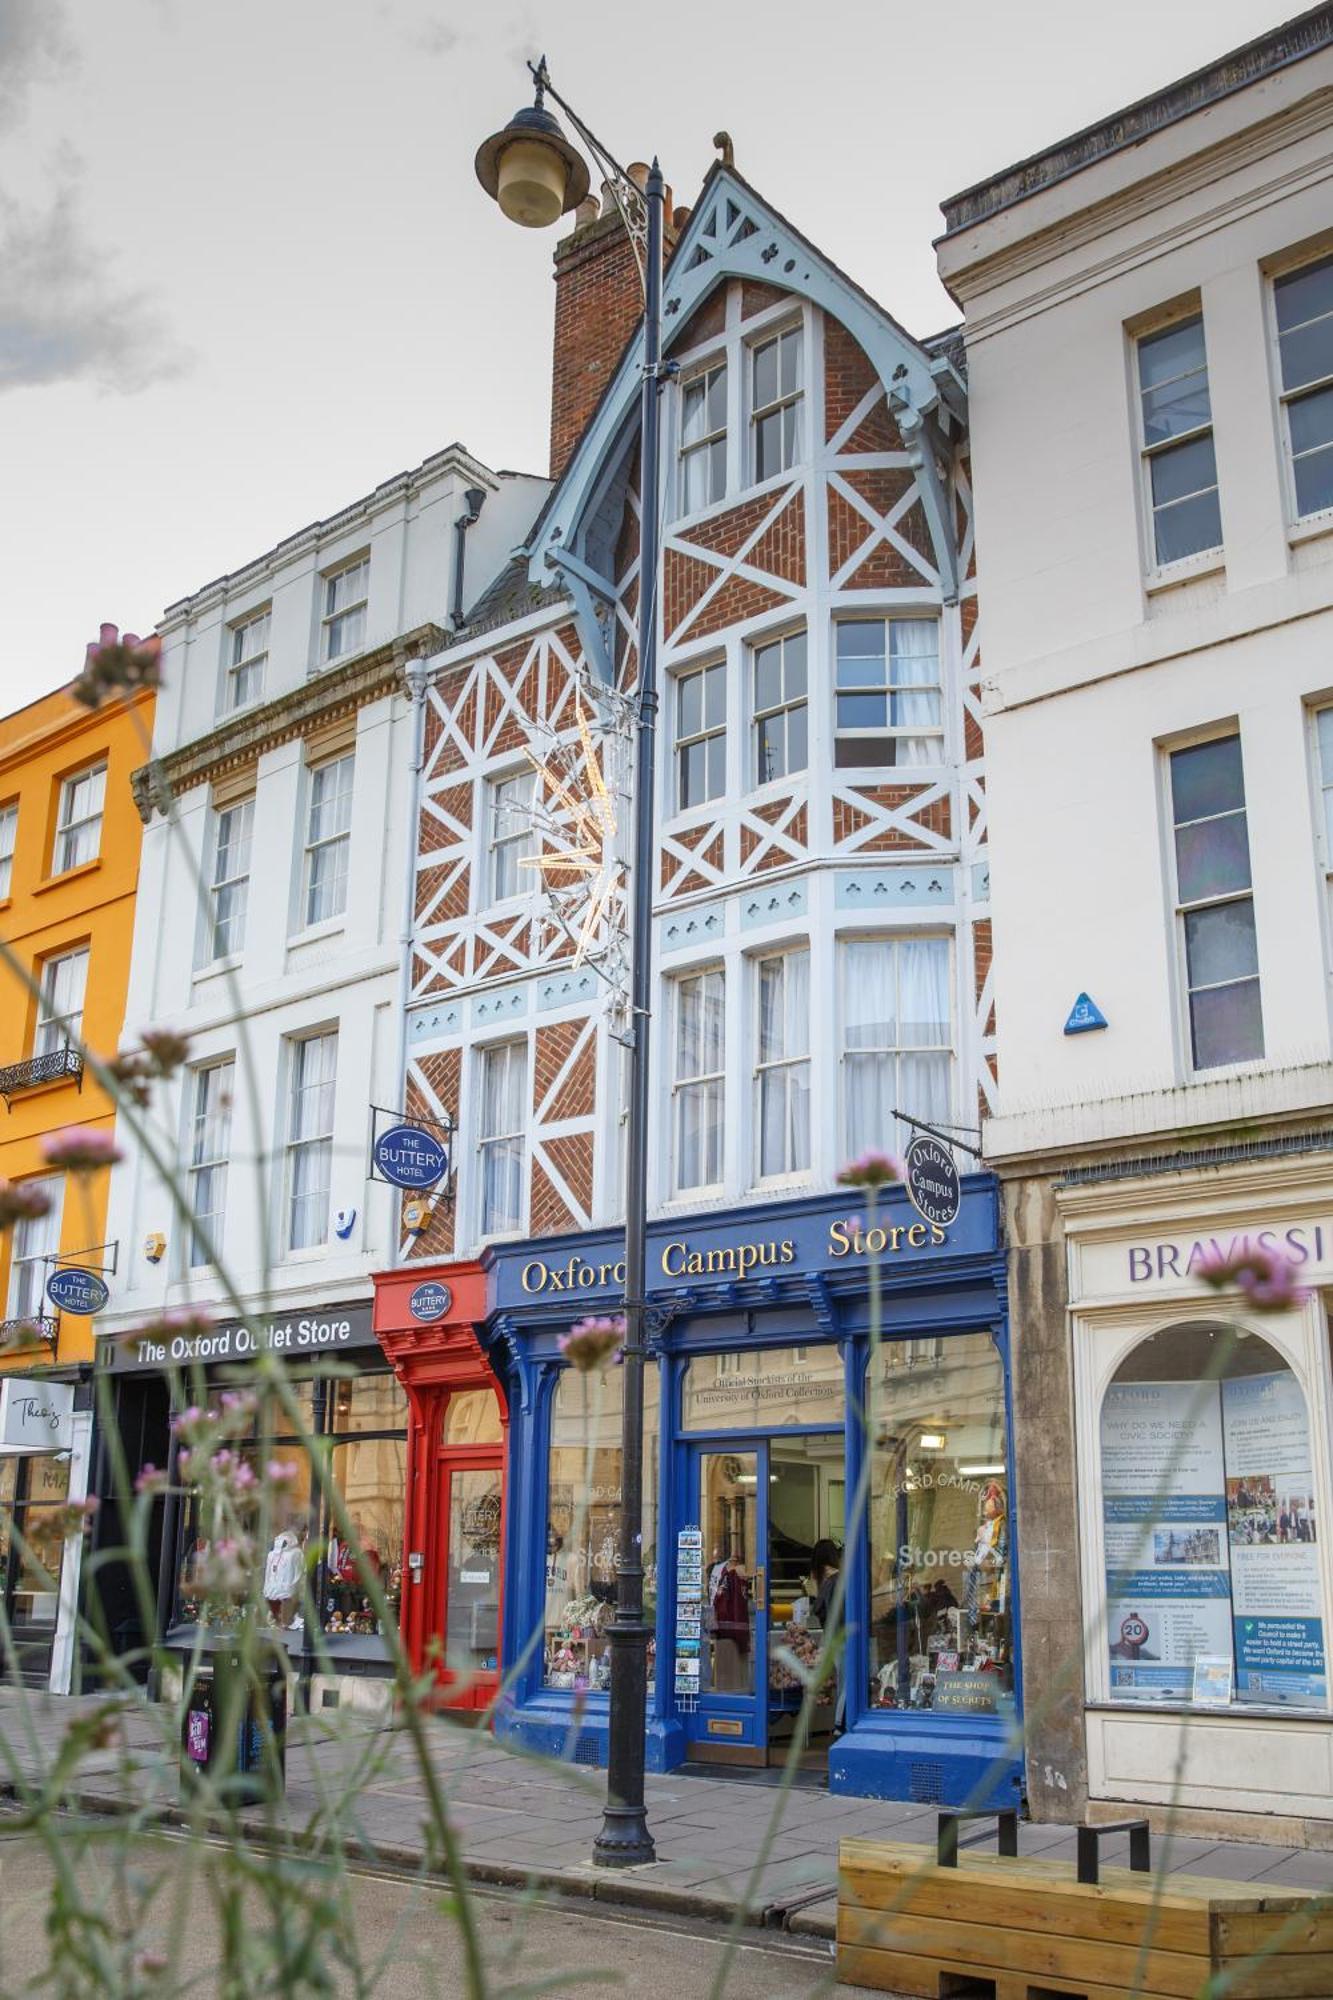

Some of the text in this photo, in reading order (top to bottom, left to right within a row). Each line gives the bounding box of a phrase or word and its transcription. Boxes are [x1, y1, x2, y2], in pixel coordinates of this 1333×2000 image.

[403, 1139, 420, 1148] THE
[380, 1147, 444, 1167] BUTTERY
[913, 1143, 953, 1178] Oxford
[397, 1167, 425, 1177] HOTEL
[912, 1168, 953, 1198] Campus
[661, 1240, 794, 1279] Campus
[828, 1220, 946, 1256] Stores
[72, 1276, 86, 1284] THE
[50, 1282, 107, 1300] BUTTERY
[65, 1299, 88, 1307] HOTEL
[411, 1295, 447, 1308] BUTTERY
[137, 1340, 166, 1362] The
[171, 1330, 230, 1360] Oxford
[296, 1320, 351, 1345] Store
[1124, 1624, 1142, 1636] 20
